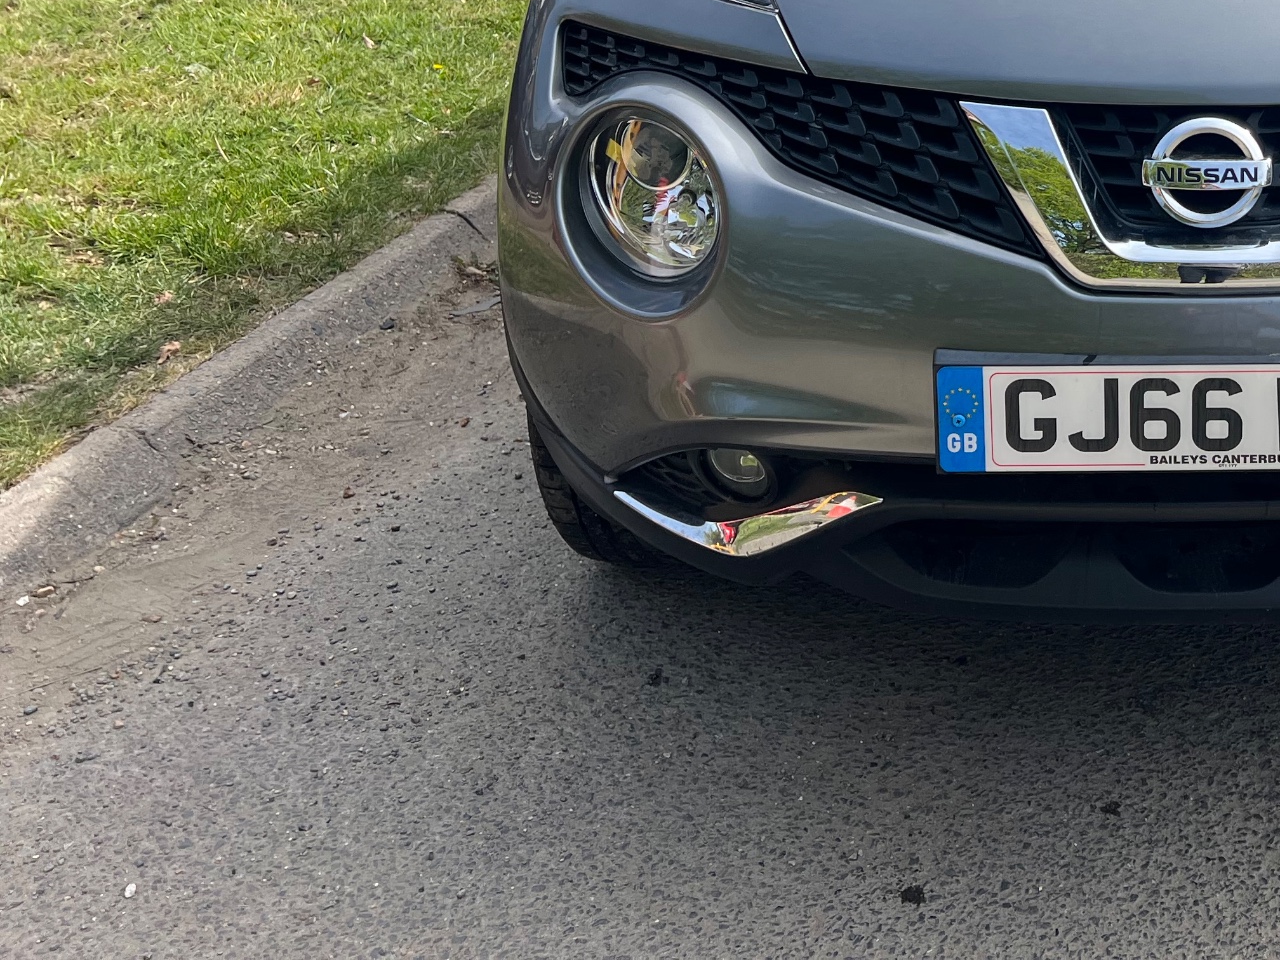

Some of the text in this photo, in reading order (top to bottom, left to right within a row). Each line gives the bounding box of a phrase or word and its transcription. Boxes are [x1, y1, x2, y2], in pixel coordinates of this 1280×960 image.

[1156, 166, 1258, 184] NISSAN
[1004, 377, 1243, 453] GJ66
[947, 433, 978, 453] GB
[1150, 455, 1208, 465] BAILEYS
